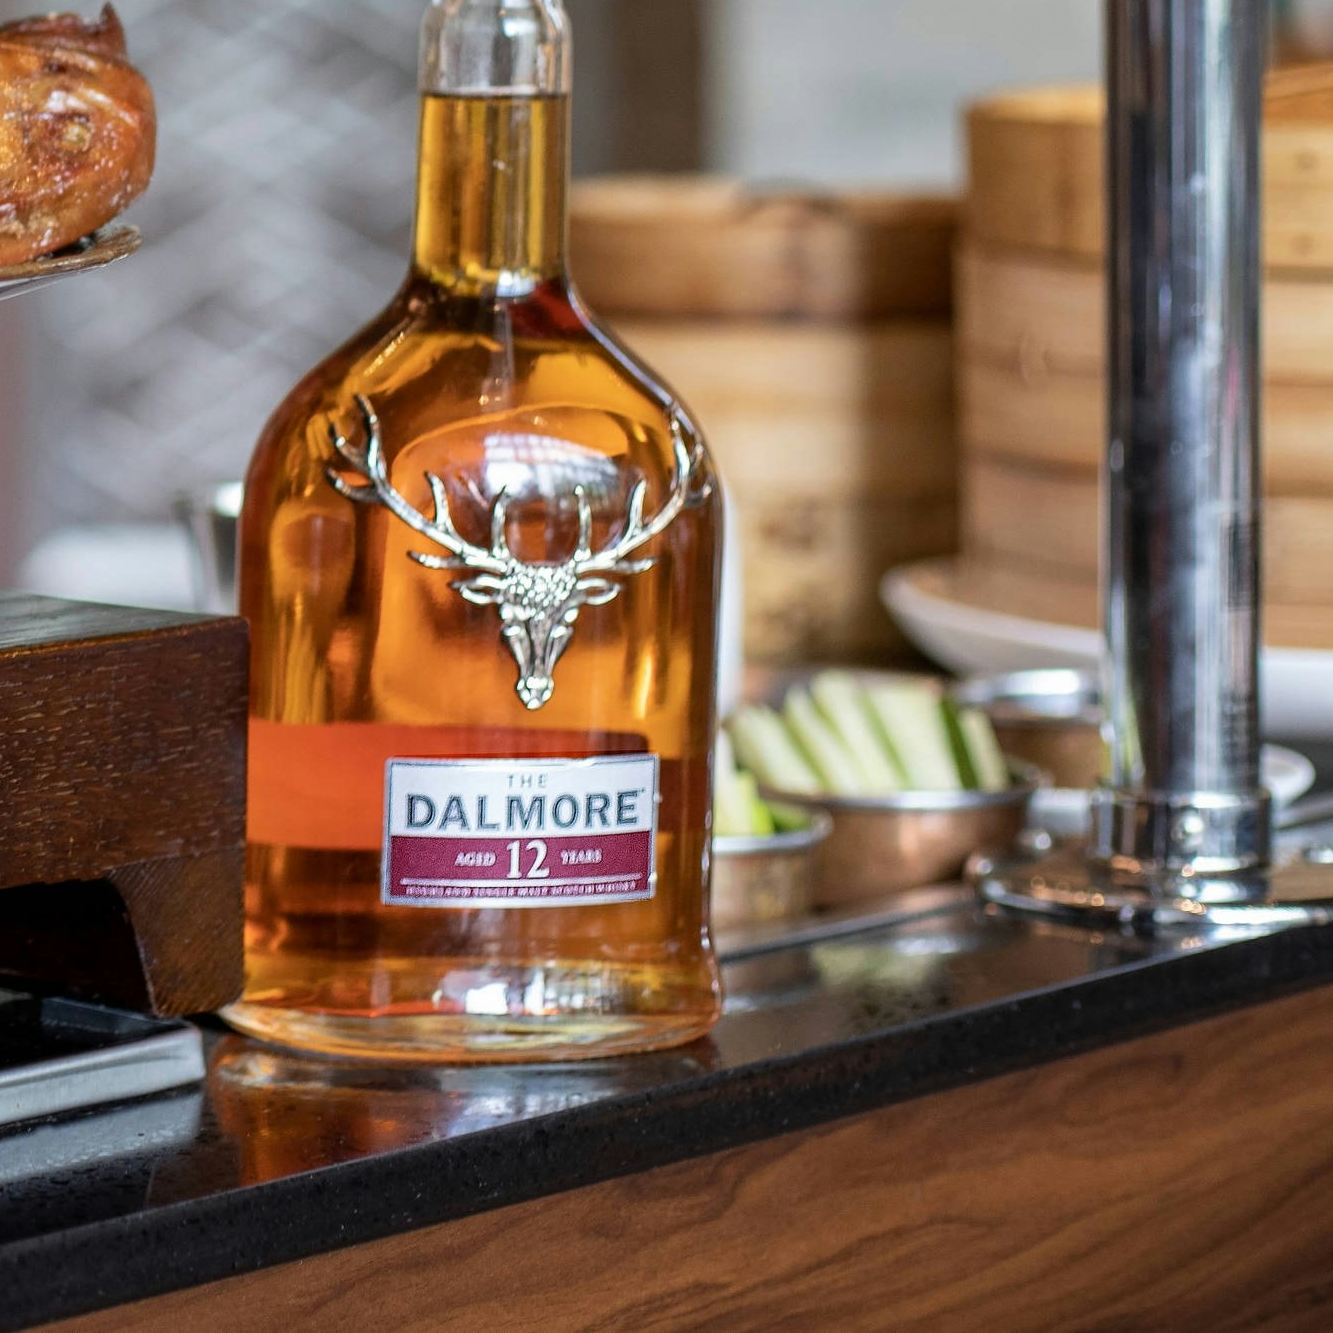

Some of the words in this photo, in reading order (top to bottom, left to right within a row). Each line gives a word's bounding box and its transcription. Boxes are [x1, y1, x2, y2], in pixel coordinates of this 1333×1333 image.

[507, 773, 549, 788] THE
[406, 790, 639, 830] DALMORE
[455, 851, 496, 867] AGED
[506, 839, 550, 879] 12
